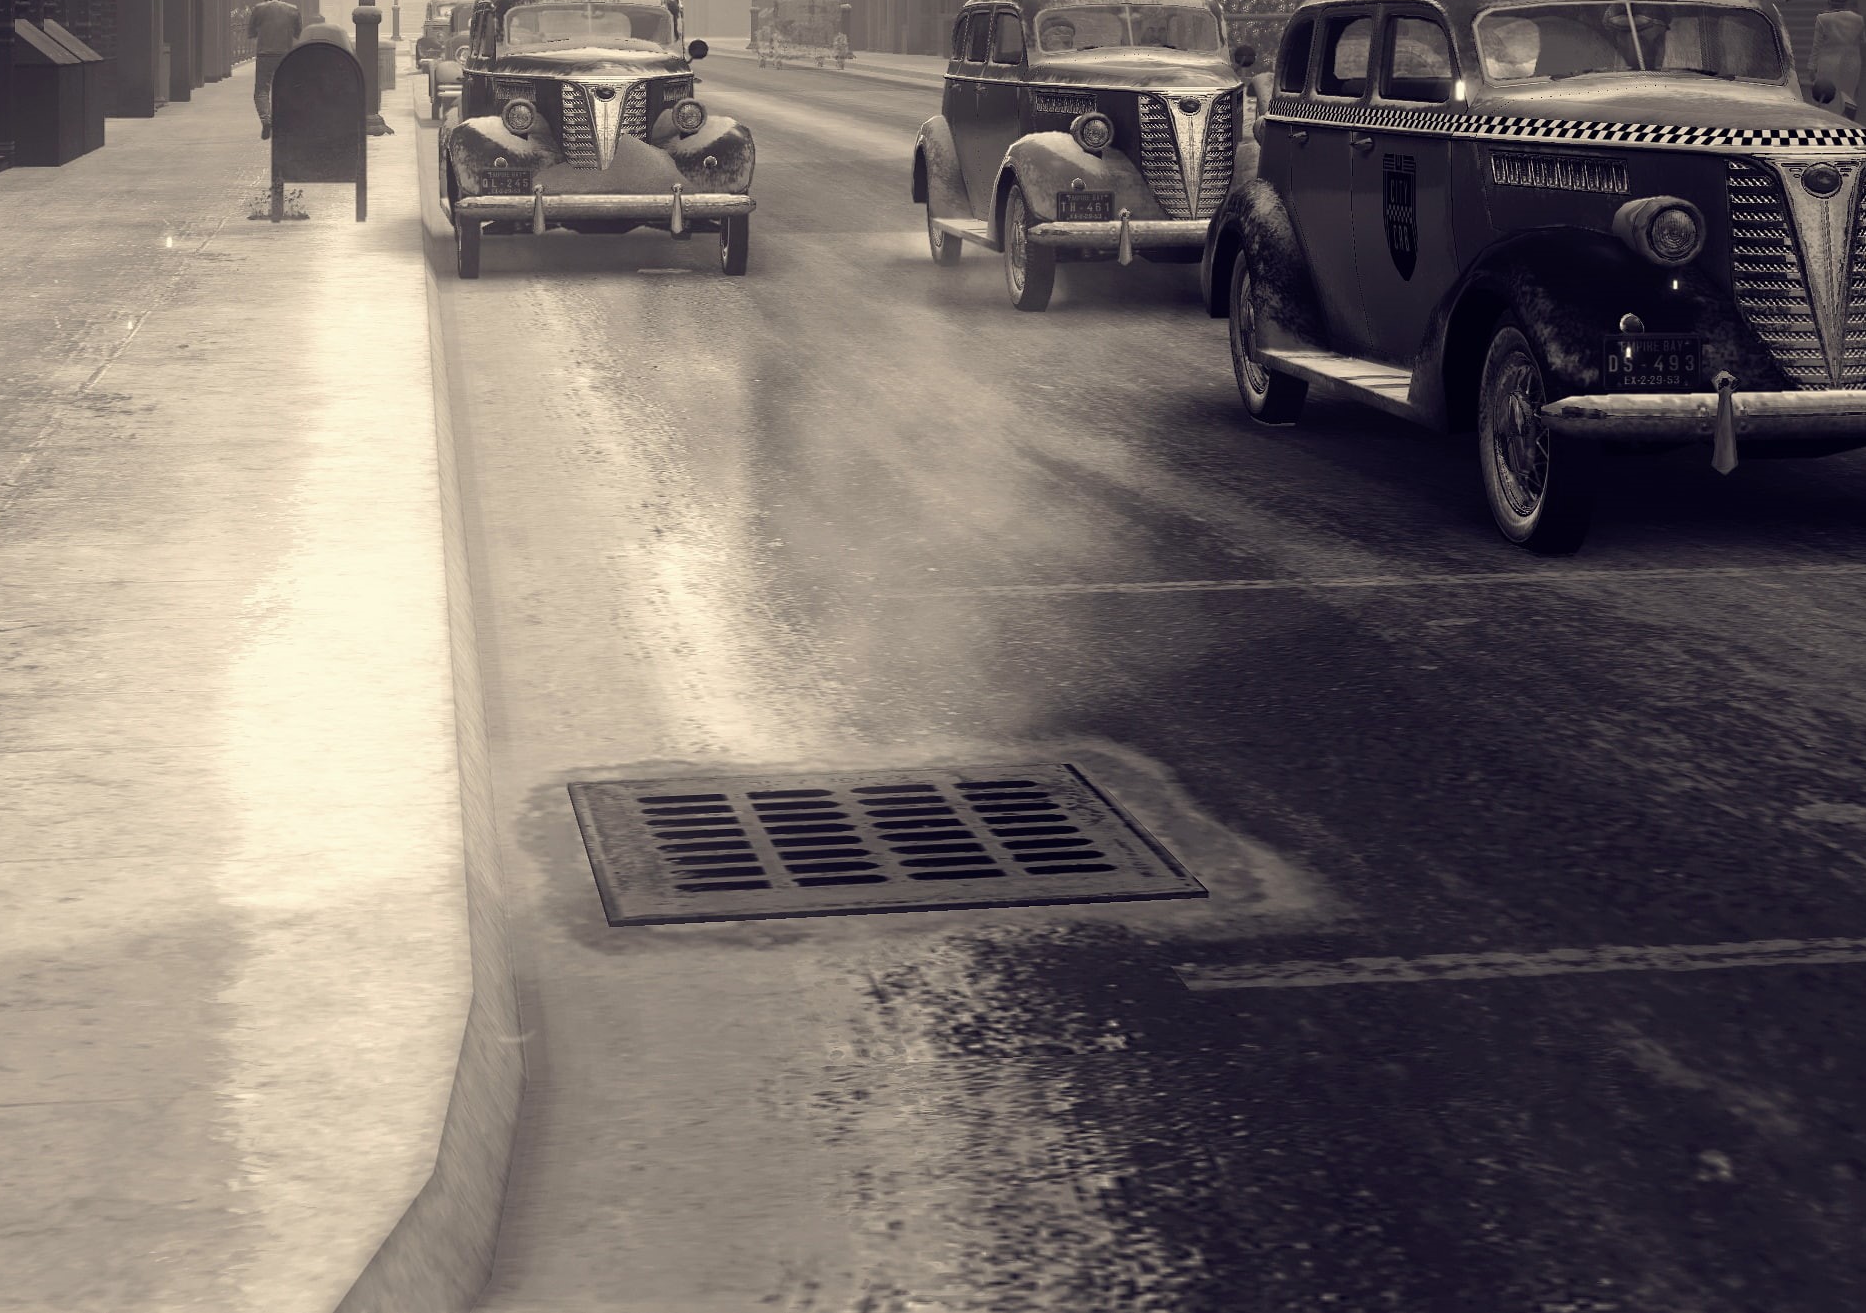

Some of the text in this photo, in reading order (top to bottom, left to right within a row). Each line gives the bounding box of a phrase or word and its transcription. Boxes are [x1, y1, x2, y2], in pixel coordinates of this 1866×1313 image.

[1390, 179, 1409, 204] CITY
[1392, 224, 1412, 252] CAB
[1620, 339, 1683, 353] EMPIRE BAY
